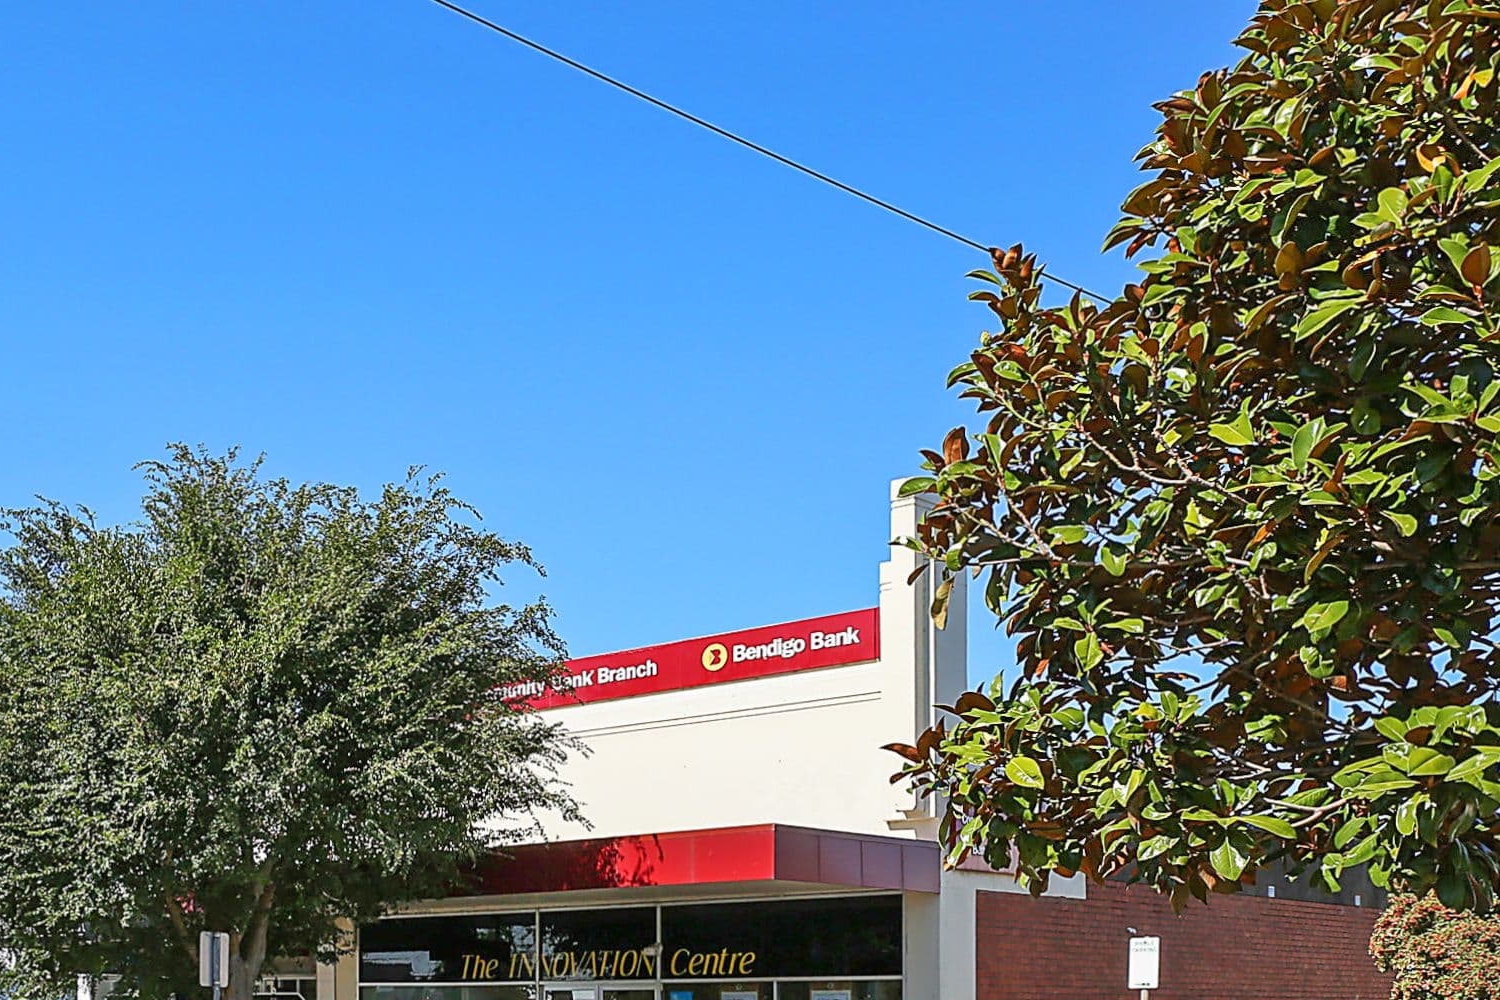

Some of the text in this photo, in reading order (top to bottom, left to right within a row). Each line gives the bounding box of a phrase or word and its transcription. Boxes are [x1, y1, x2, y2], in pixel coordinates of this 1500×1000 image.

[732, 626, 860, 662] Bendigo Bank
[597, 659, 658, 684] Branch
[461, 947, 756, 980] The INNOVATION Centre
